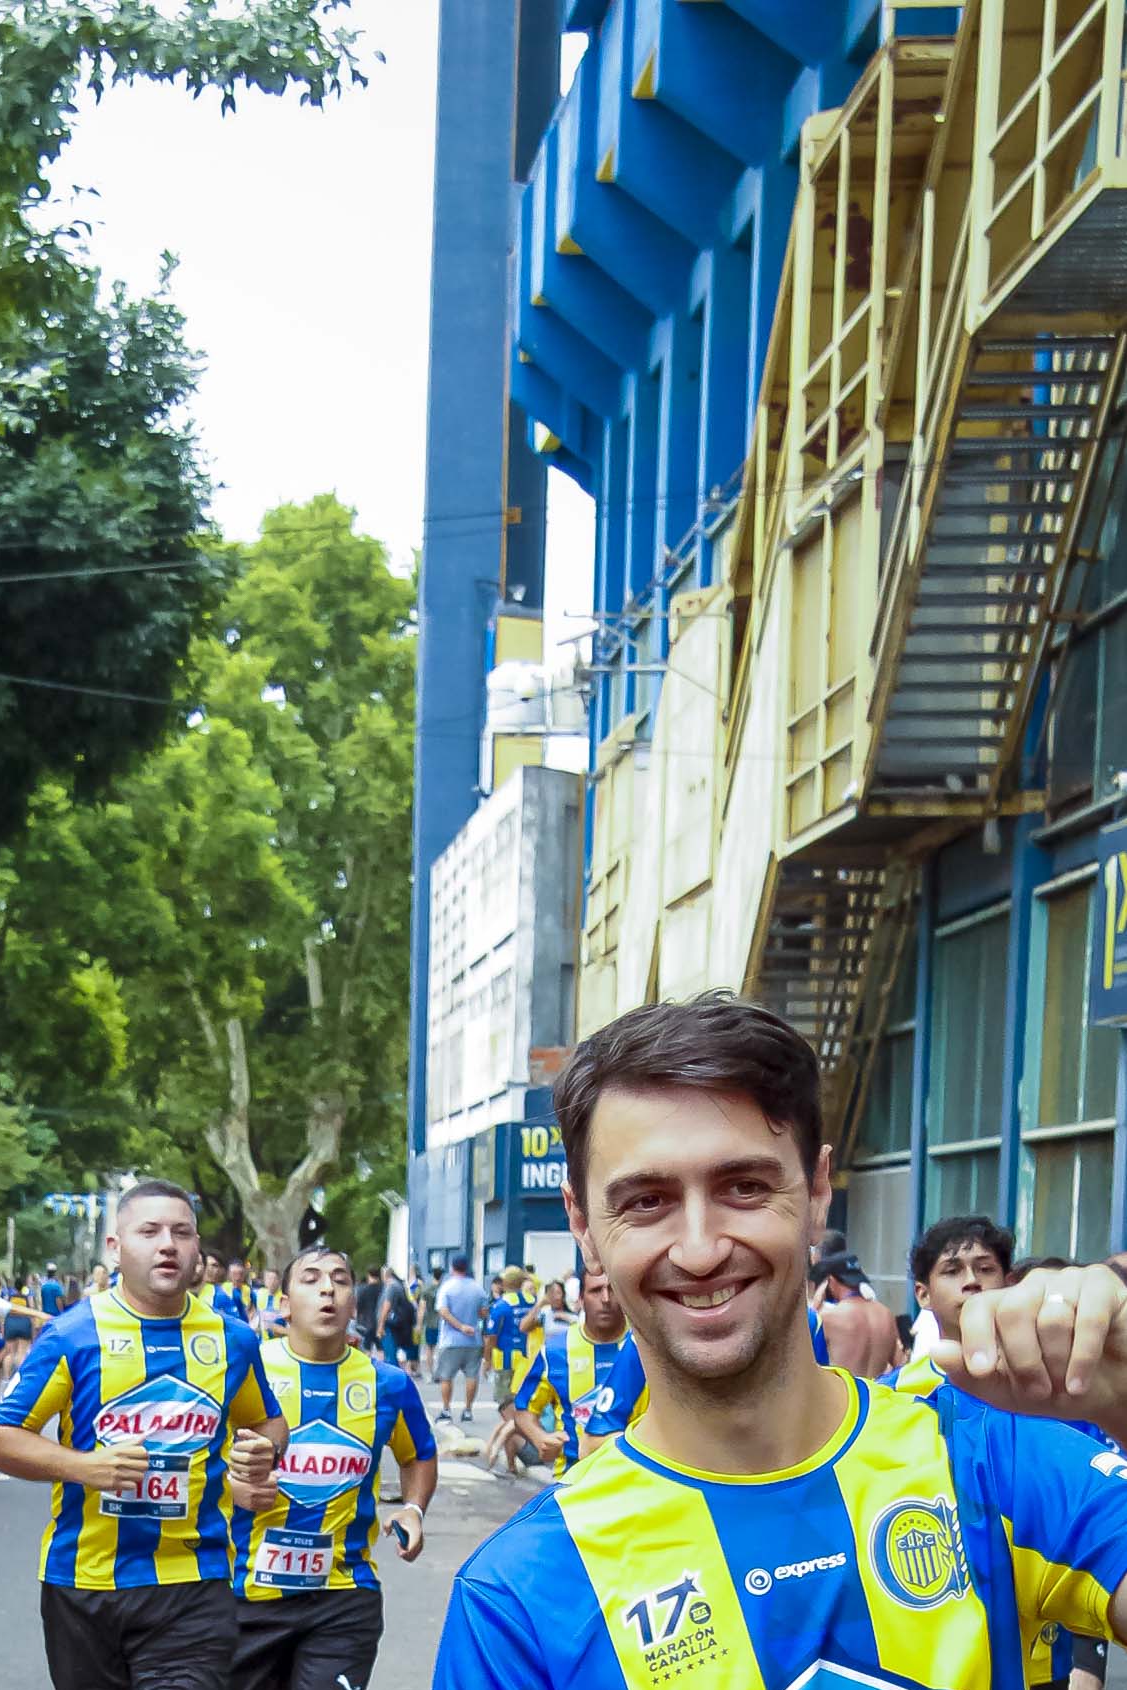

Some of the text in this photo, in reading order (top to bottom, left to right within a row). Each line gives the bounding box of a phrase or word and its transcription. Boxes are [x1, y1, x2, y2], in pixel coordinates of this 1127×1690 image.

[278, 1454, 370, 1476] ALADINI
[266, 1549, 324, 1575] 7115
[774, 1551, 847, 1581] express
[626, 1576, 699, 1648] 17
[645, 1627, 716, 1664] MARATÓN
[649, 1639, 718, 1673] CANALLA
